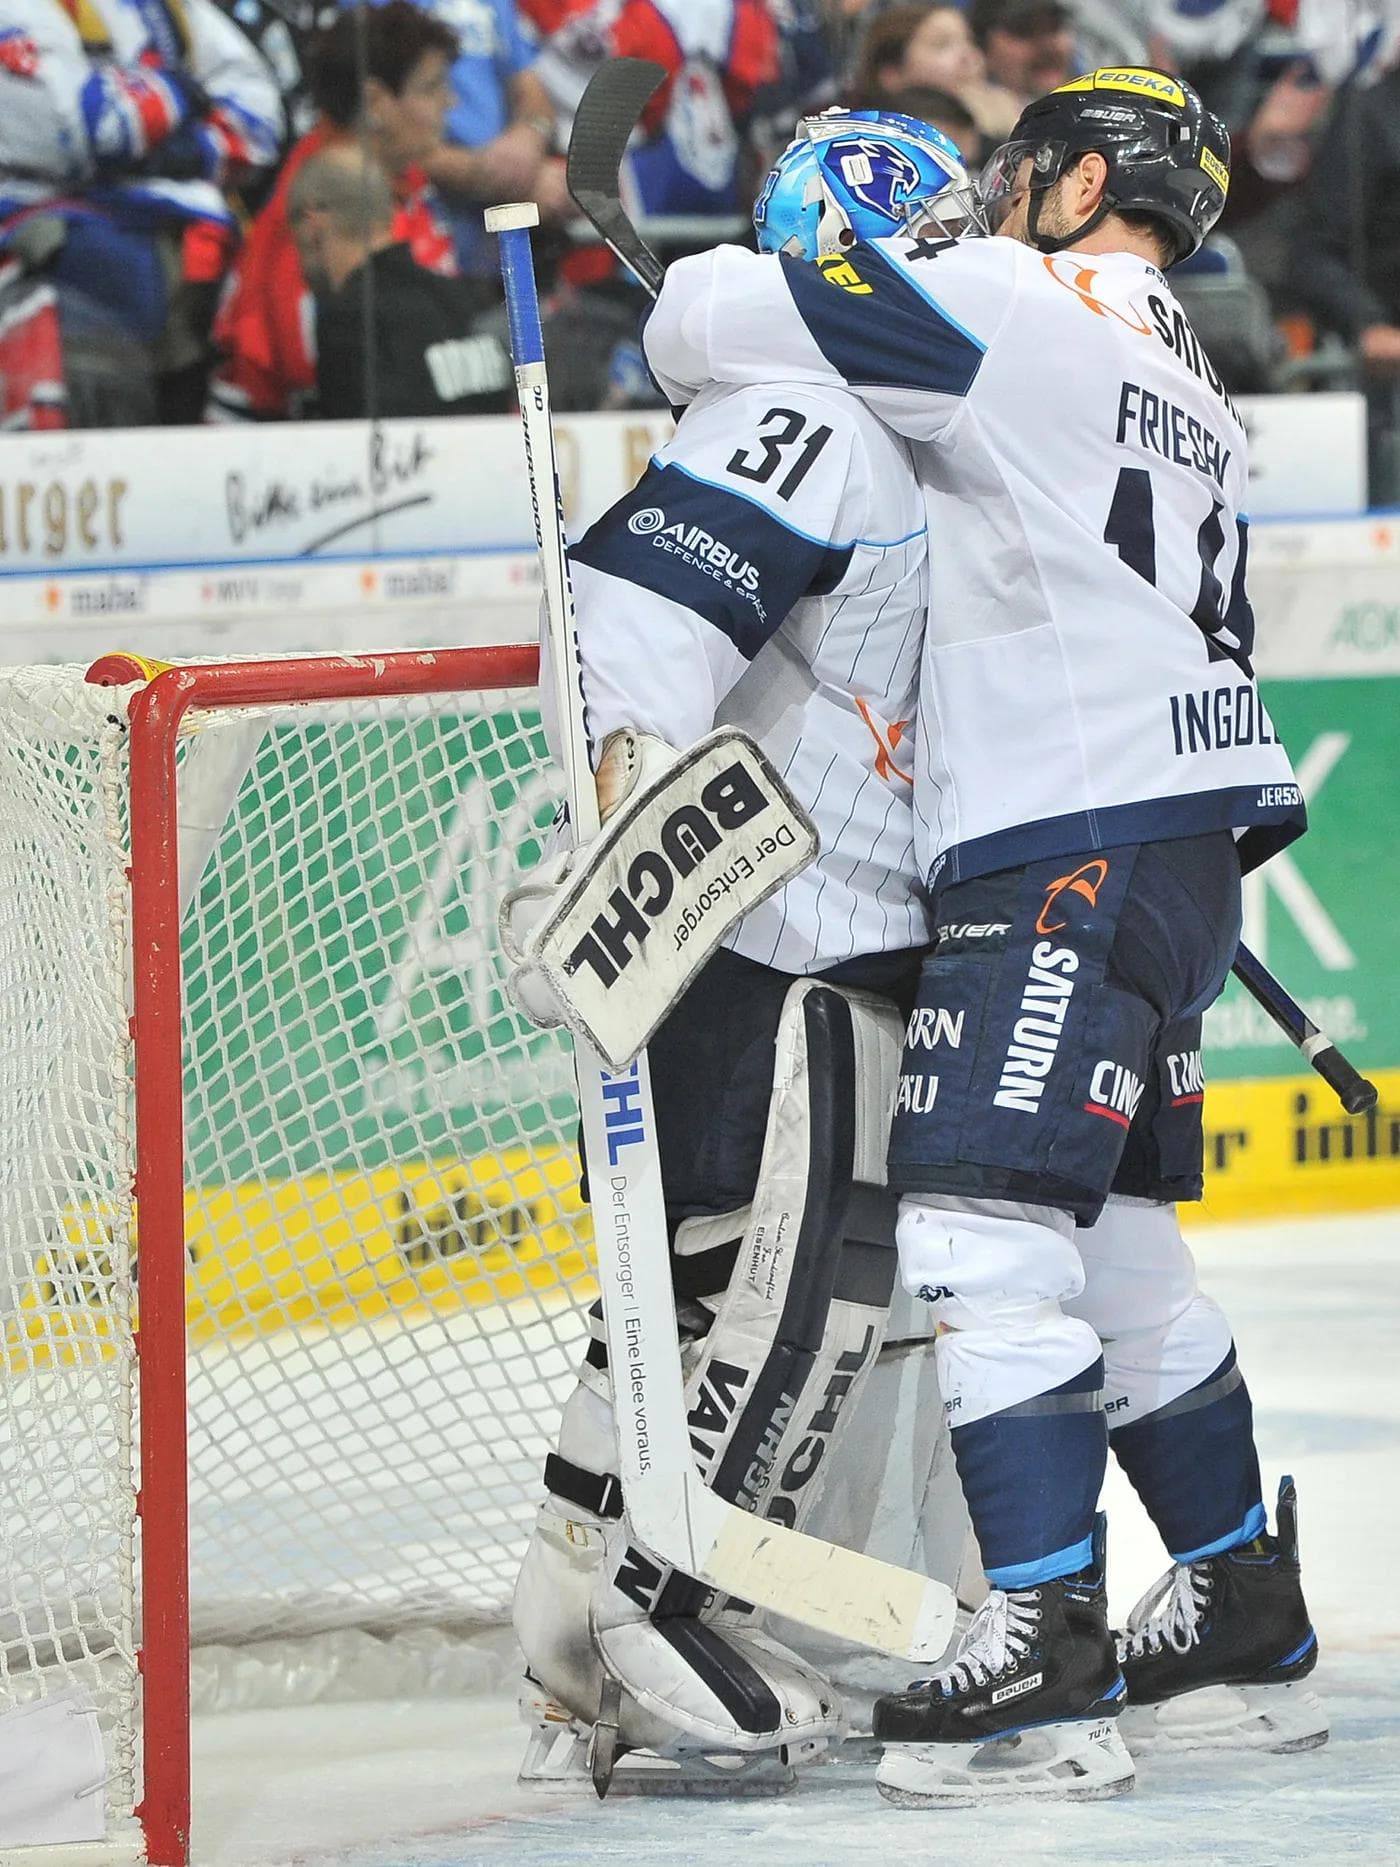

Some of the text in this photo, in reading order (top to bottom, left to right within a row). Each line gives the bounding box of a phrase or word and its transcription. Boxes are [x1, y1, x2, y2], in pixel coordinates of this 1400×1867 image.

[1080, 108, 1137, 123] BAUER
[1097, 72, 1177, 98] EDEKA
[725, 407, 834, 503] 31
[1115, 380, 1232, 490] FRIESEN
[0, 477, 128, 557] rger
[651, 534, 722, 586] DEFENCE
[660, 522, 760, 592] AIRBUS
[1169, 684, 1284, 756] INGOL
[561, 760, 770, 990] BÜCHL
[674, 823, 796, 952] Der Entsorger
[992, 940, 1080, 1114] SATURN
[747, 1226, 765, 1283] EISENHUT
[610, 1175, 652, 1477] Der Entsorger Eine Idee voraus.
[996, 1675, 1039, 1701] BAUER
